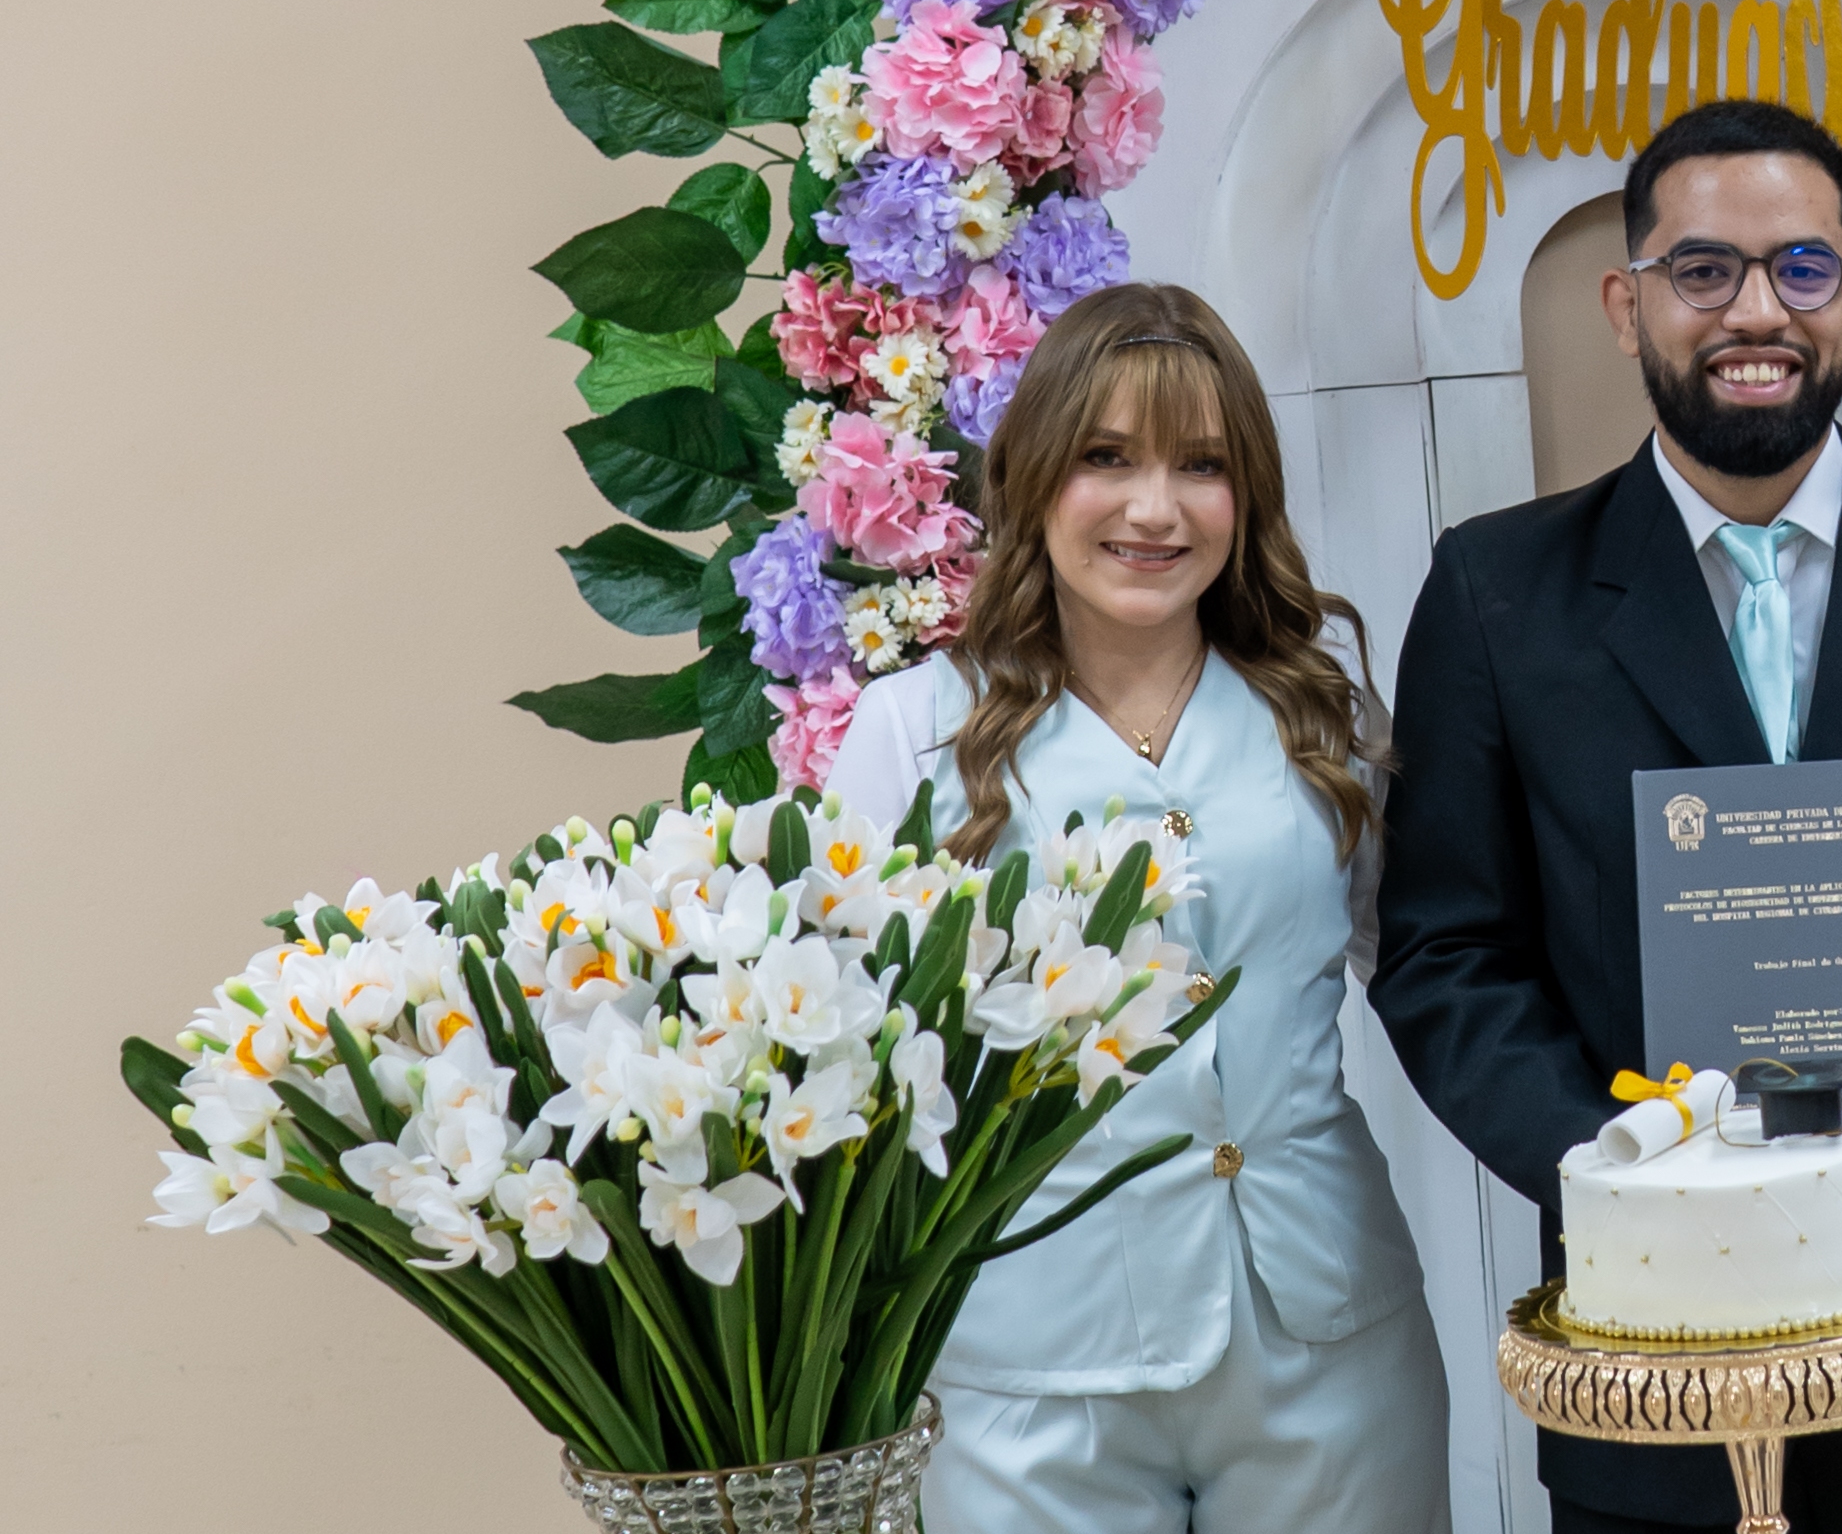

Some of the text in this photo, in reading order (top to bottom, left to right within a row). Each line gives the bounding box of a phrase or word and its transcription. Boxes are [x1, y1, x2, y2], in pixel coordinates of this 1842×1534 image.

[1715, 810, 1782, 824] UNIVERSIDAD
[1786, 807, 1830, 821] PRIVADA
[1721, 824, 1763, 836] FACULTAD
[1764, 823, 1776, 833] DE
[1779, 821, 1820, 833] CIENCIAS
[1748, 834, 1785, 845] CARRERA
[1786, 833, 1799, 843] DE
[1679, 889, 1720, 900] FACTORES
[1804, 883, 1816, 894] LA
[1663, 901, 1713, 913] PROTOCOLOS
[1753, 959, 1789, 971] Trabajo
[1791, 957, 1817, 968] Final
[1820, 956, 1832, 967] de
